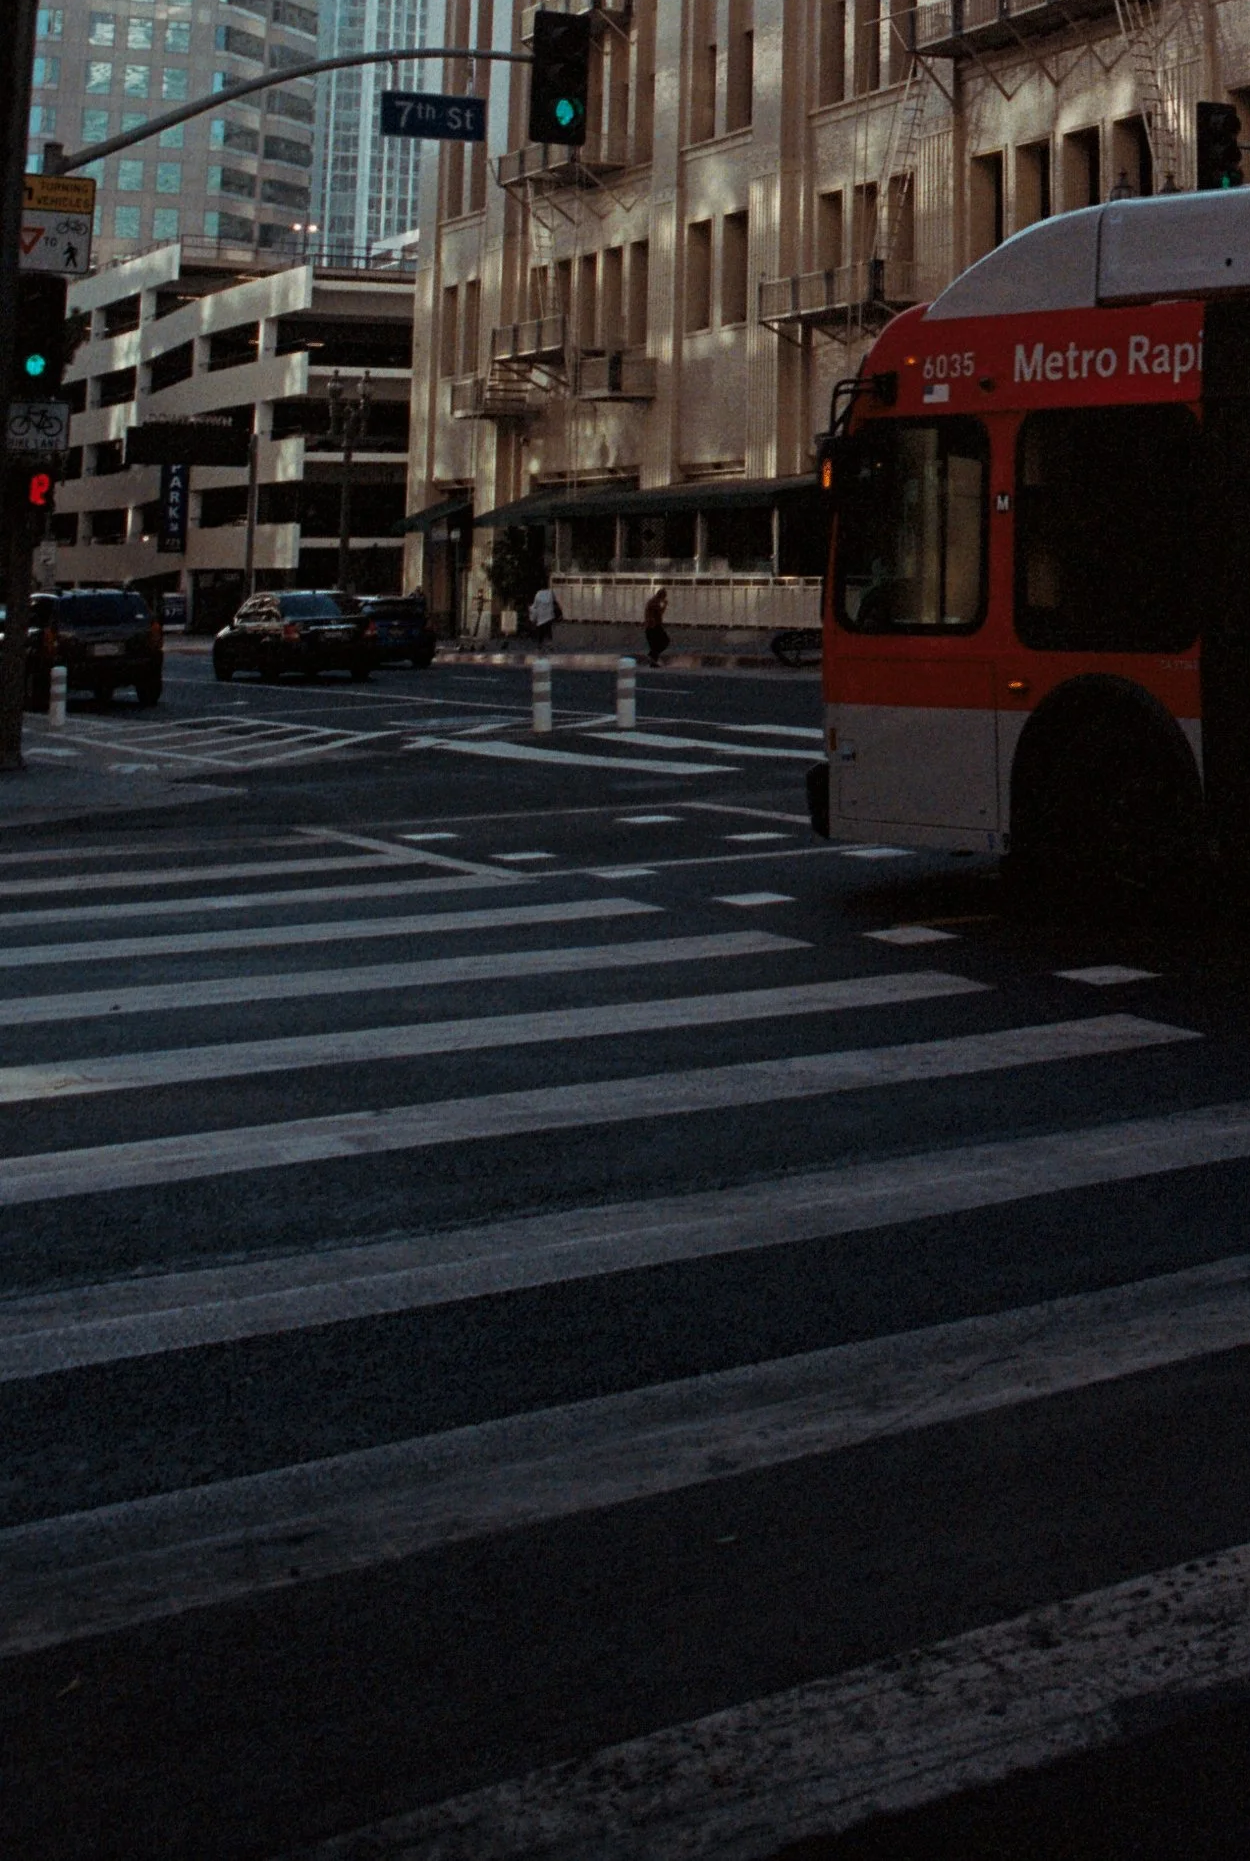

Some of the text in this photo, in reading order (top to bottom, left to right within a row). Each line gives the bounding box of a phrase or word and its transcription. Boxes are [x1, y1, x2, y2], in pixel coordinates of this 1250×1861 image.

[394, 100, 475, 132] 7th St
[44, 237, 57, 247] TO
[922, 351, 976, 380] 6035
[1013, 341, 1117, 383] Metro
